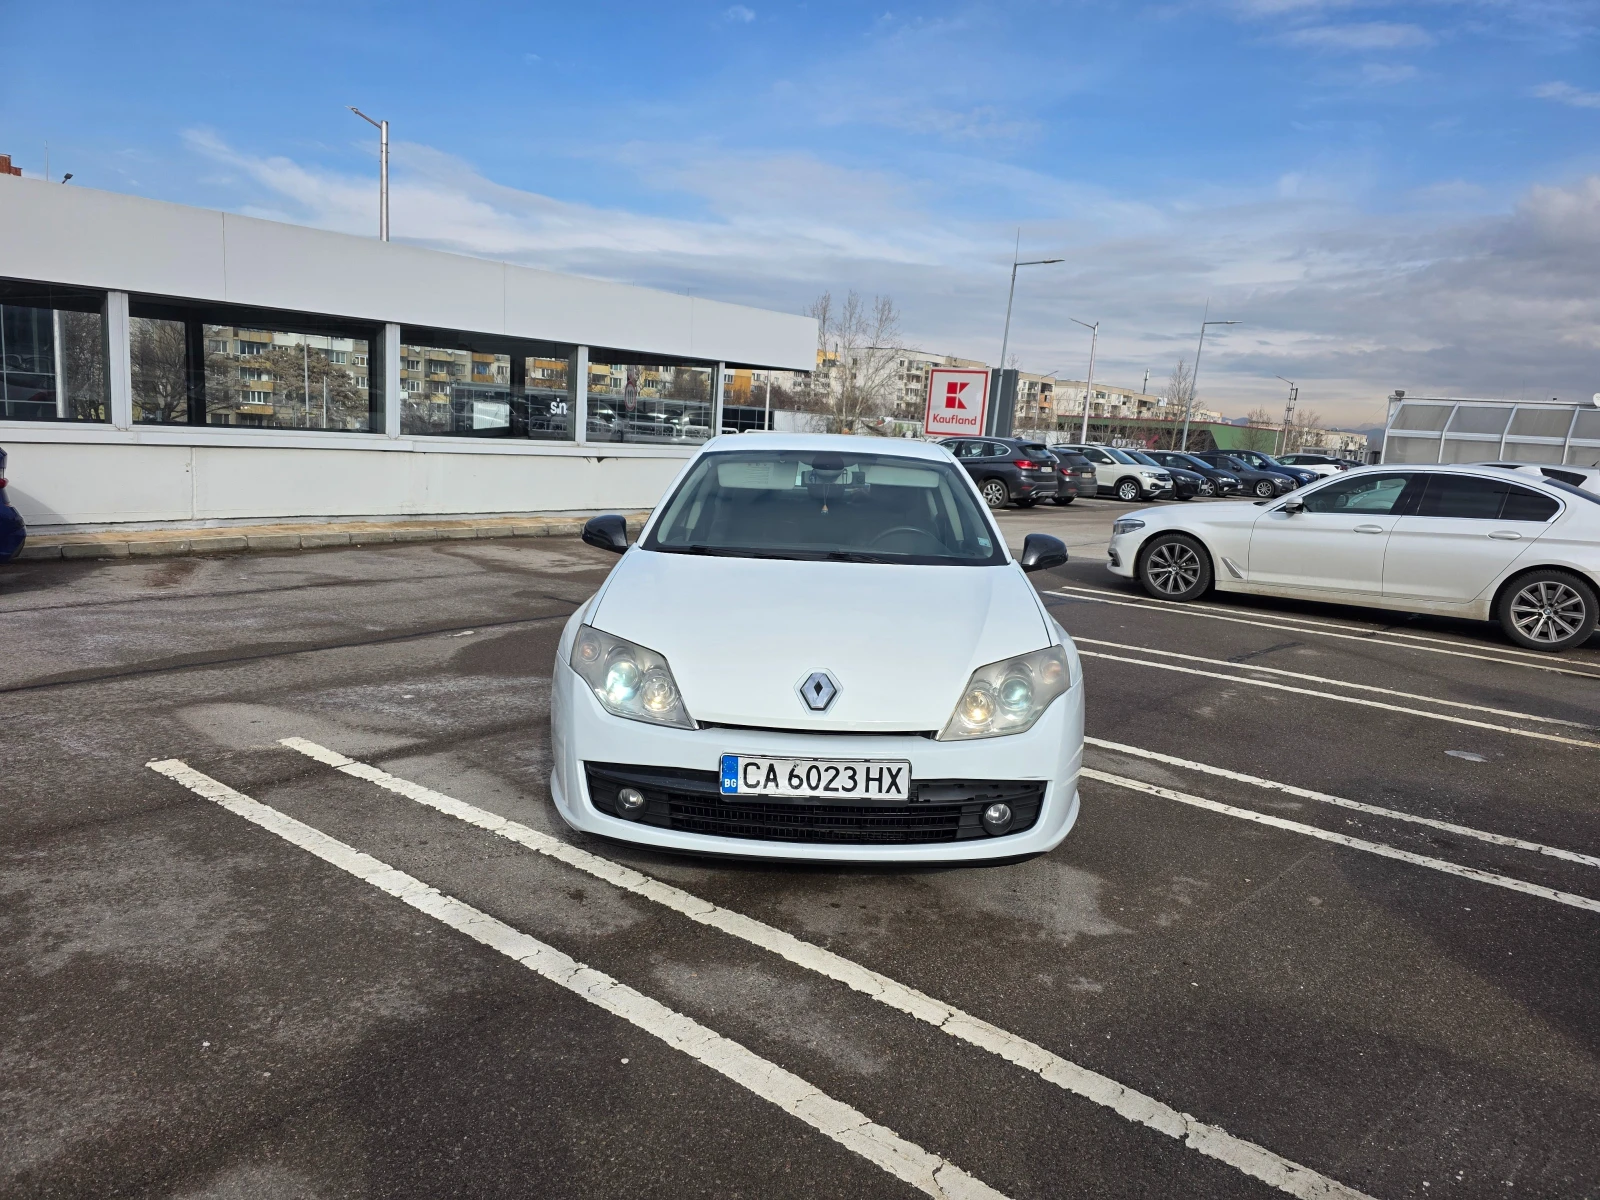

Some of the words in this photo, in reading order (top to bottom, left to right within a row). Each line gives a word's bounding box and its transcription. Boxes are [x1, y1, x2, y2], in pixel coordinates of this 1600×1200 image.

[932, 413, 977, 425] Kaufland
[724, 779, 737, 788] BG
[743, 762, 779, 789] CA
[788, 763, 858, 793] 6023
[865, 766, 903, 794] HX
